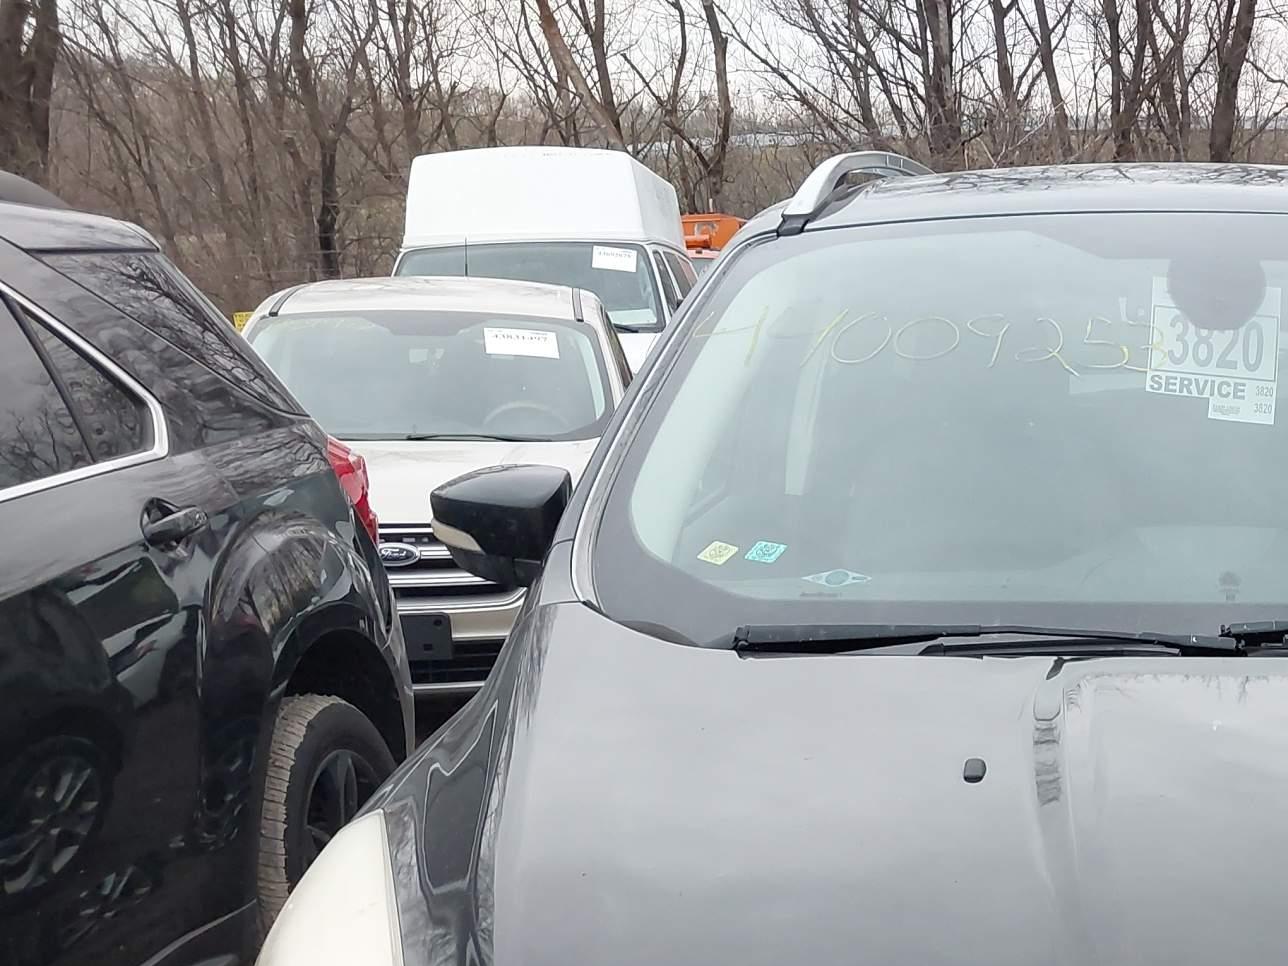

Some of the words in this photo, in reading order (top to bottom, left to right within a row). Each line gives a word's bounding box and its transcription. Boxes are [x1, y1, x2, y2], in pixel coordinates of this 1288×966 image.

[1167, 314, 1264, 373] 3820
[1149, 374, 1247, 400] SERVICE
[1255, 385, 1274, 398] 3820
